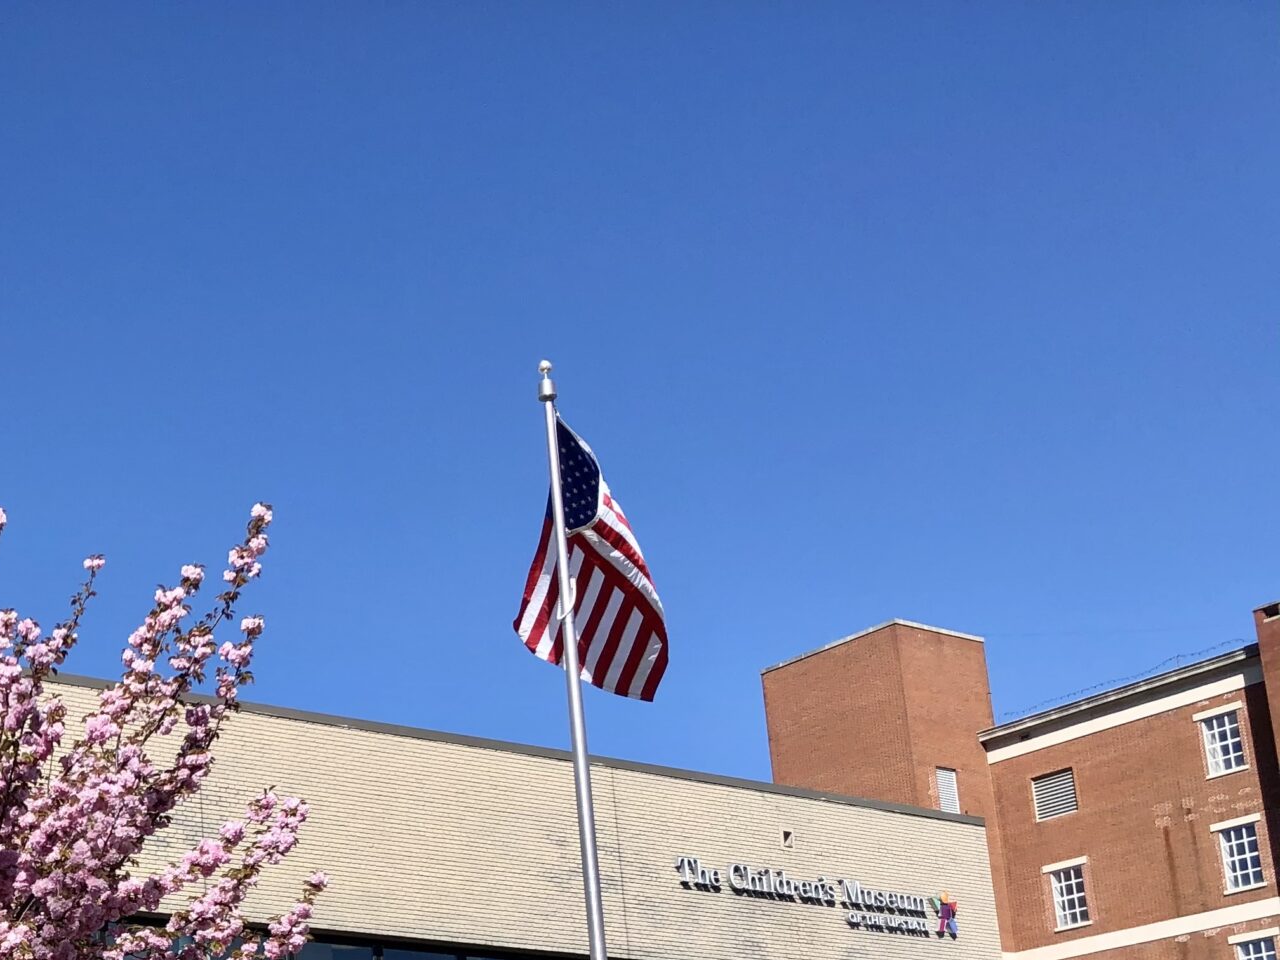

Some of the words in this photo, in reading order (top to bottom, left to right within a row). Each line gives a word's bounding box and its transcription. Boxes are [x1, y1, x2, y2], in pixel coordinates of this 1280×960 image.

[677, 856, 721, 886] The
[728, 864, 835, 900] Children's
[840, 879, 927, 912] Museum
[848, 911, 863, 923] OF
[866, 914, 886, 926] THE
[887, 917, 930, 931] UPSTATE
